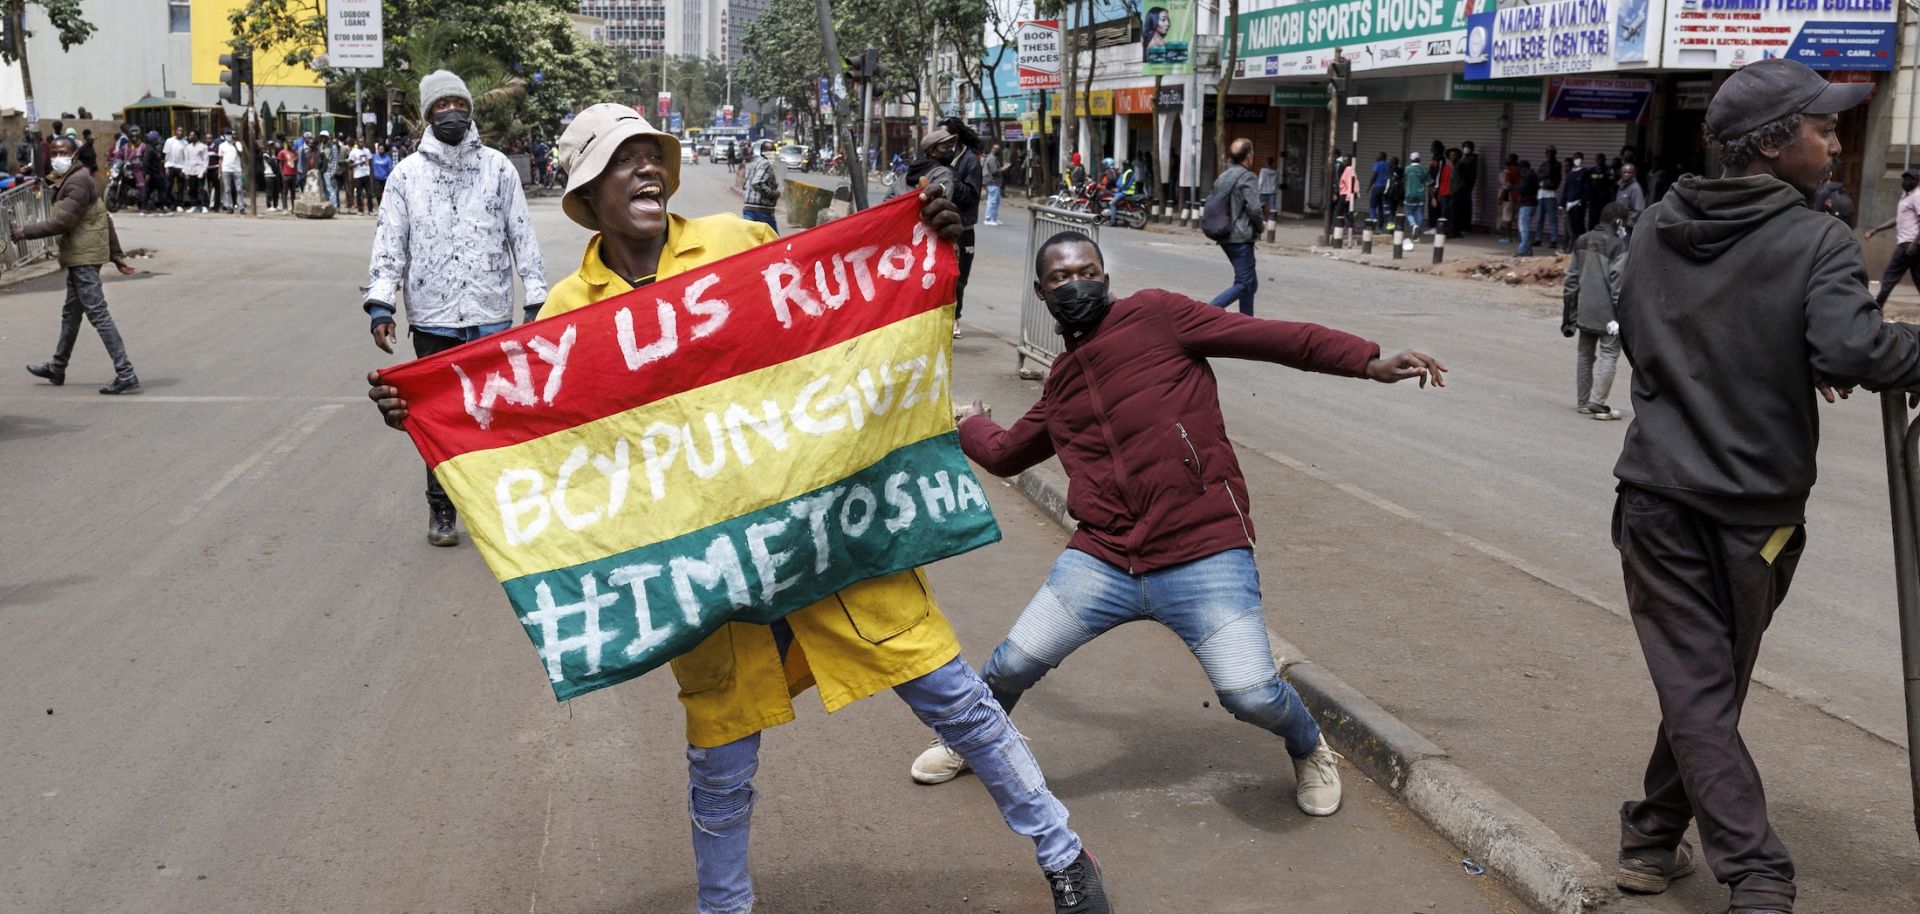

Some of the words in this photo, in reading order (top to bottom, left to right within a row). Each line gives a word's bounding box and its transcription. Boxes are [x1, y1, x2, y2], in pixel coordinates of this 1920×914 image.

[1777, 0, 1818, 10] TECH
[1823, 0, 1892, 11] COLLEGE
[1500, 6, 1545, 33] NAIROBI
[1549, 0, 1608, 28] AVIATION
[1711, 12, 1726, 20] FOOD
[1248, 10, 1304, 50] NAIROBI
[1307, 0, 1372, 44] SPORTS
[1376, 0, 1444, 34] HOUSE
[1024, 32, 1054, 40] BOOK
[1717, 38, 1750, 46] ELECTRICAL
[1023, 43, 1056, 52] THESE
[1493, 35, 1546, 62] COLLEGE
[1020, 54, 1060, 63] SPACES
[1503, 63, 1529, 76] SECOND
[1539, 61, 1560, 73] THIRD
[1562, 60, 1592, 72] FLOORS
[451, 324, 577, 430] WY
[614, 273, 731, 371] US
[520, 470, 990, 682] #IMETOSHA
